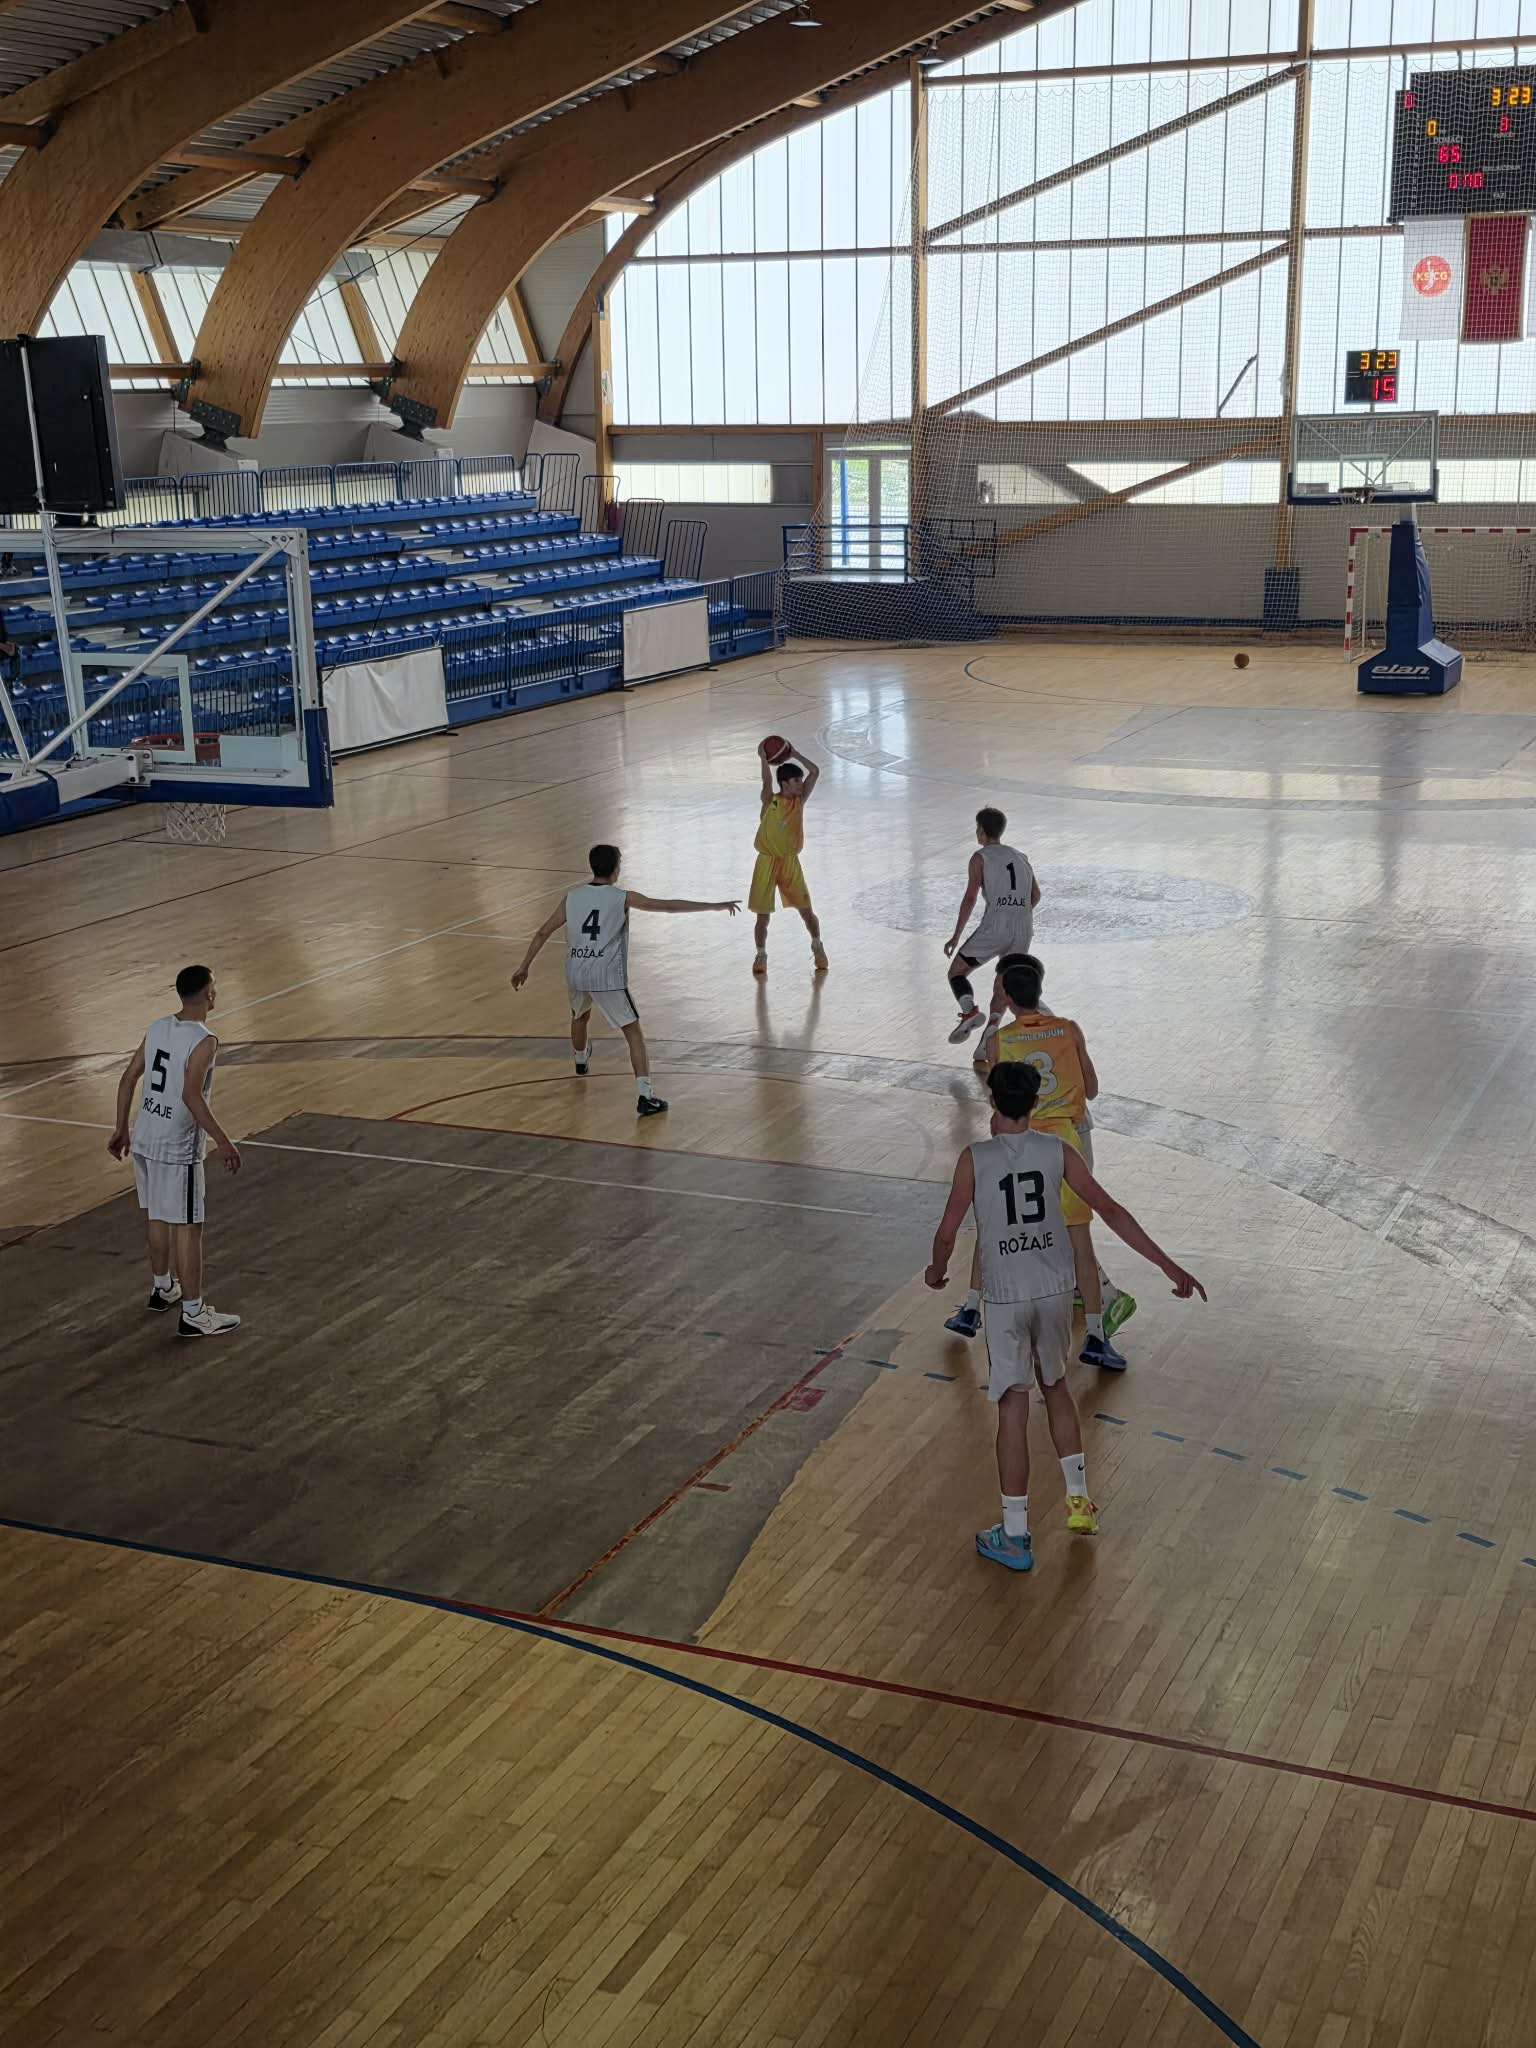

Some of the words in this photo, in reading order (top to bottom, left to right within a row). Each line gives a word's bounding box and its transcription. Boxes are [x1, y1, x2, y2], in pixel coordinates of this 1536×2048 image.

[1427, 119, 1437, 137] 0
[1438, 144, 1461, 163] 65
[1374, 377, 1395, 401] 15
[1371, 664, 1430, 674] elan
[1006, 862, 1017, 891] 1
[581, 909, 601, 941] 4
[151, 1049, 171, 1093] 5
[999, 1170, 1046, 1226] 13
[999, 1231, 1054, 1256] ROŽAJE
